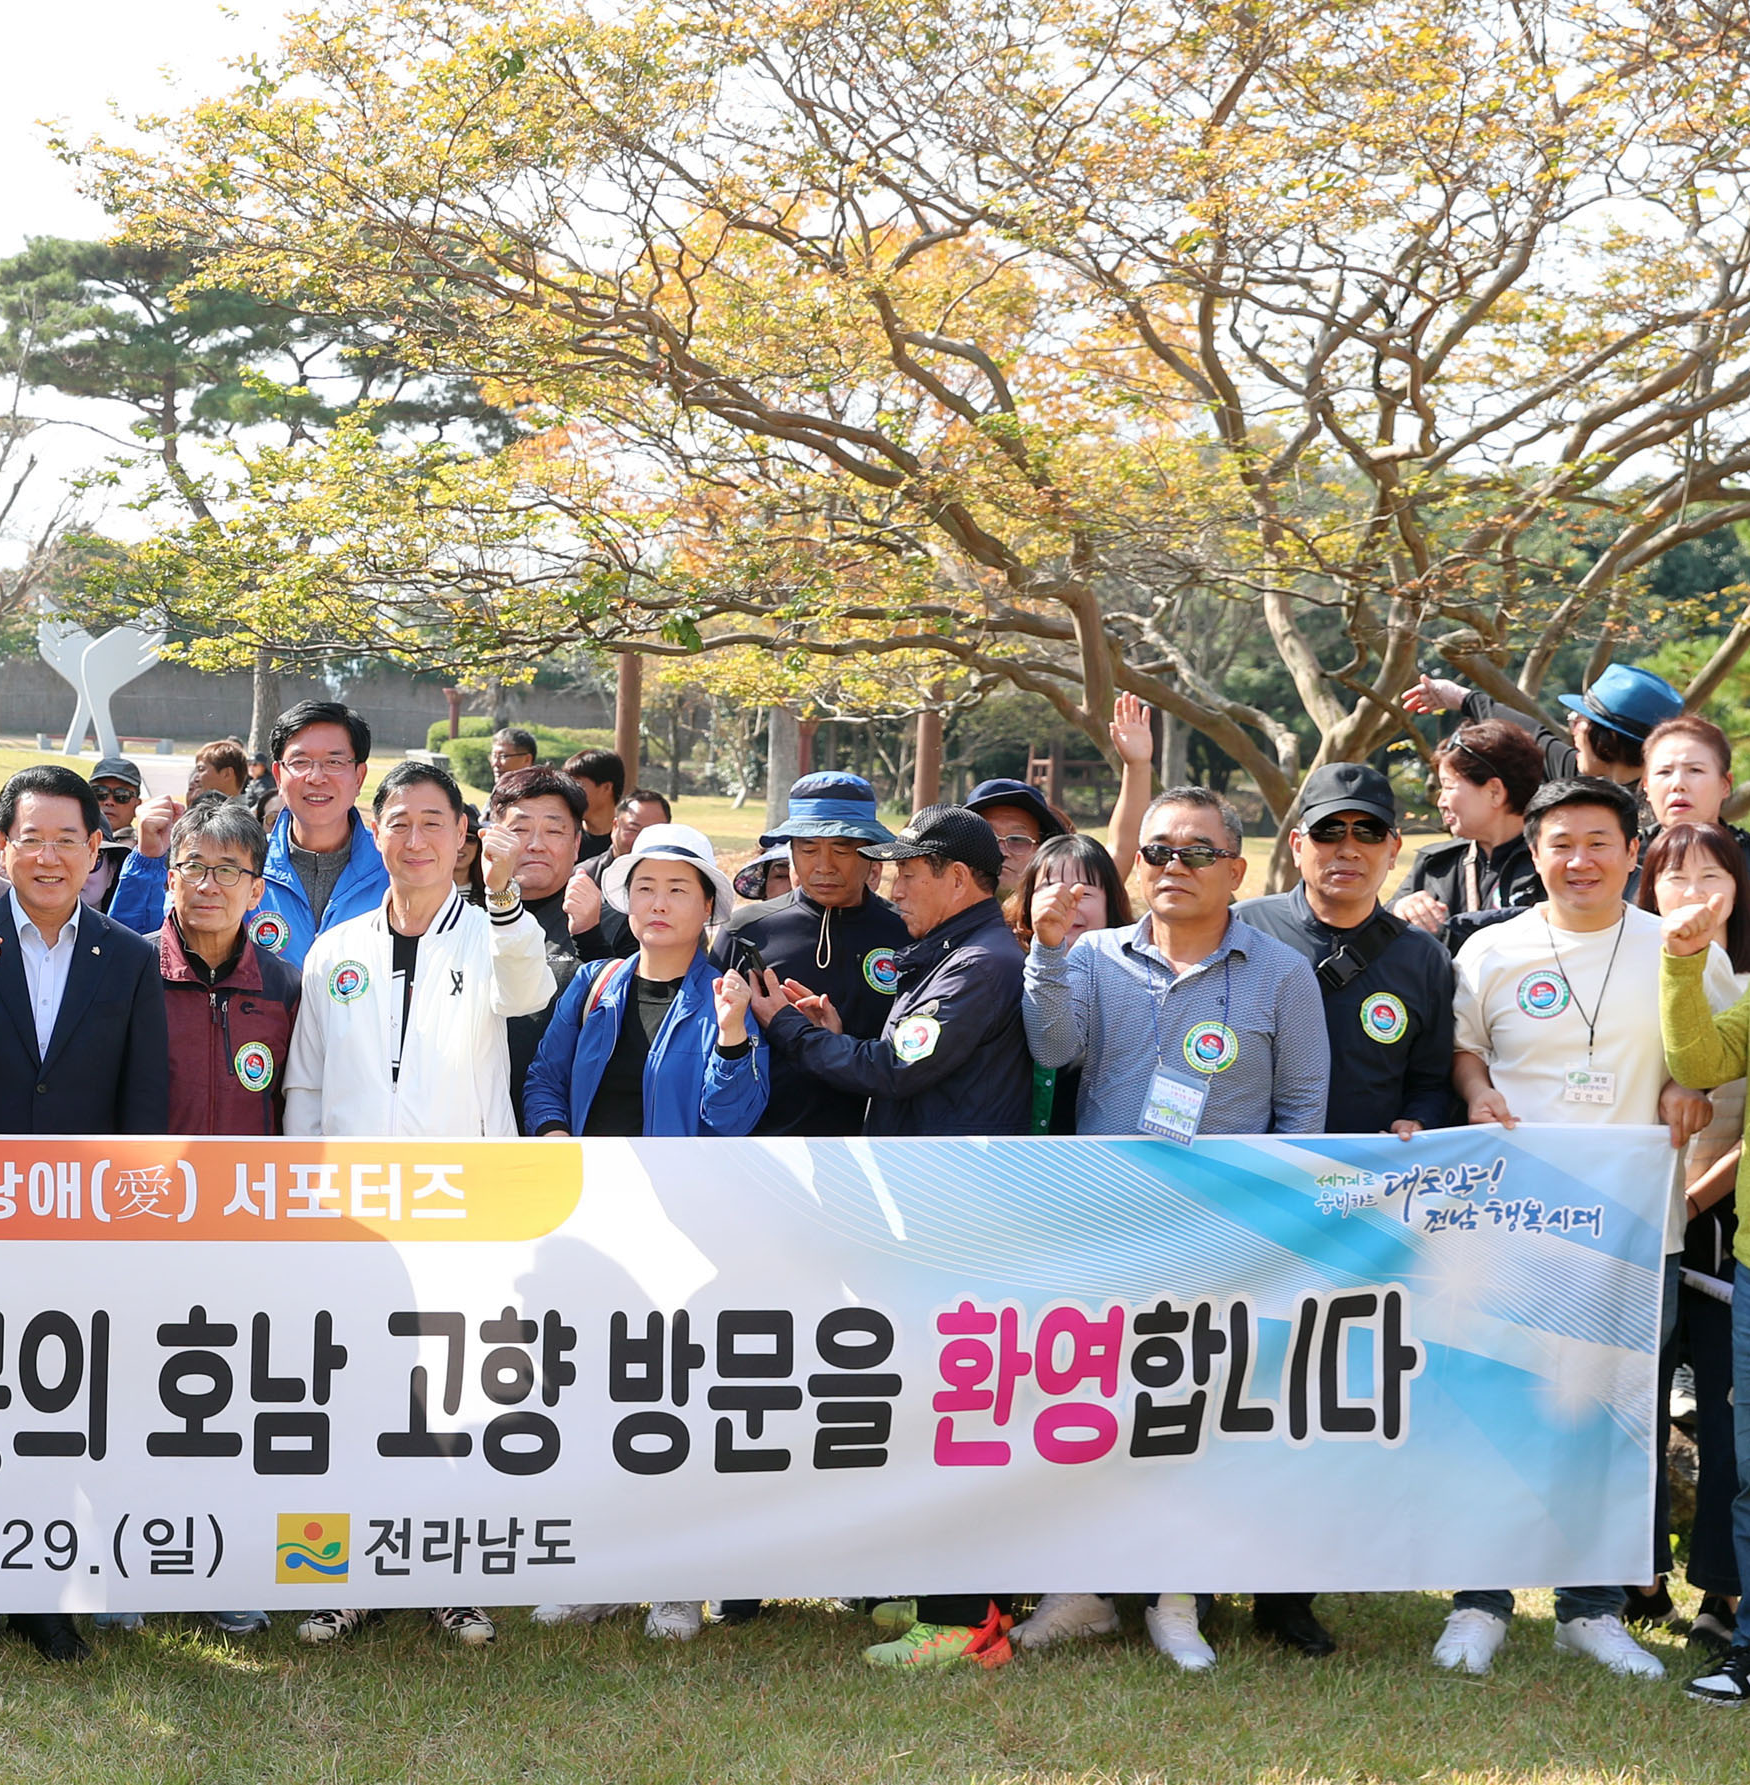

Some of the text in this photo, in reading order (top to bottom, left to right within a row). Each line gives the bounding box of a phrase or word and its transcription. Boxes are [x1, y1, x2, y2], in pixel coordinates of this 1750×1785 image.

[224, 1162, 468, 1222] 서포터즈
[1316, 1172, 1375, 1188] 세계로
[1424, 1203, 1478, 1232] 전남
[146, 1304, 348, 1475] 호남
[376, 1306, 577, 1476] 고향
[609, 1307, 903, 1476] 방문을
[932, 1290, 1418, 1467] 환영합니다
[0, 1513, 224, 1579] 29.(일)
[364, 1517, 576, 1576] 전라남도
